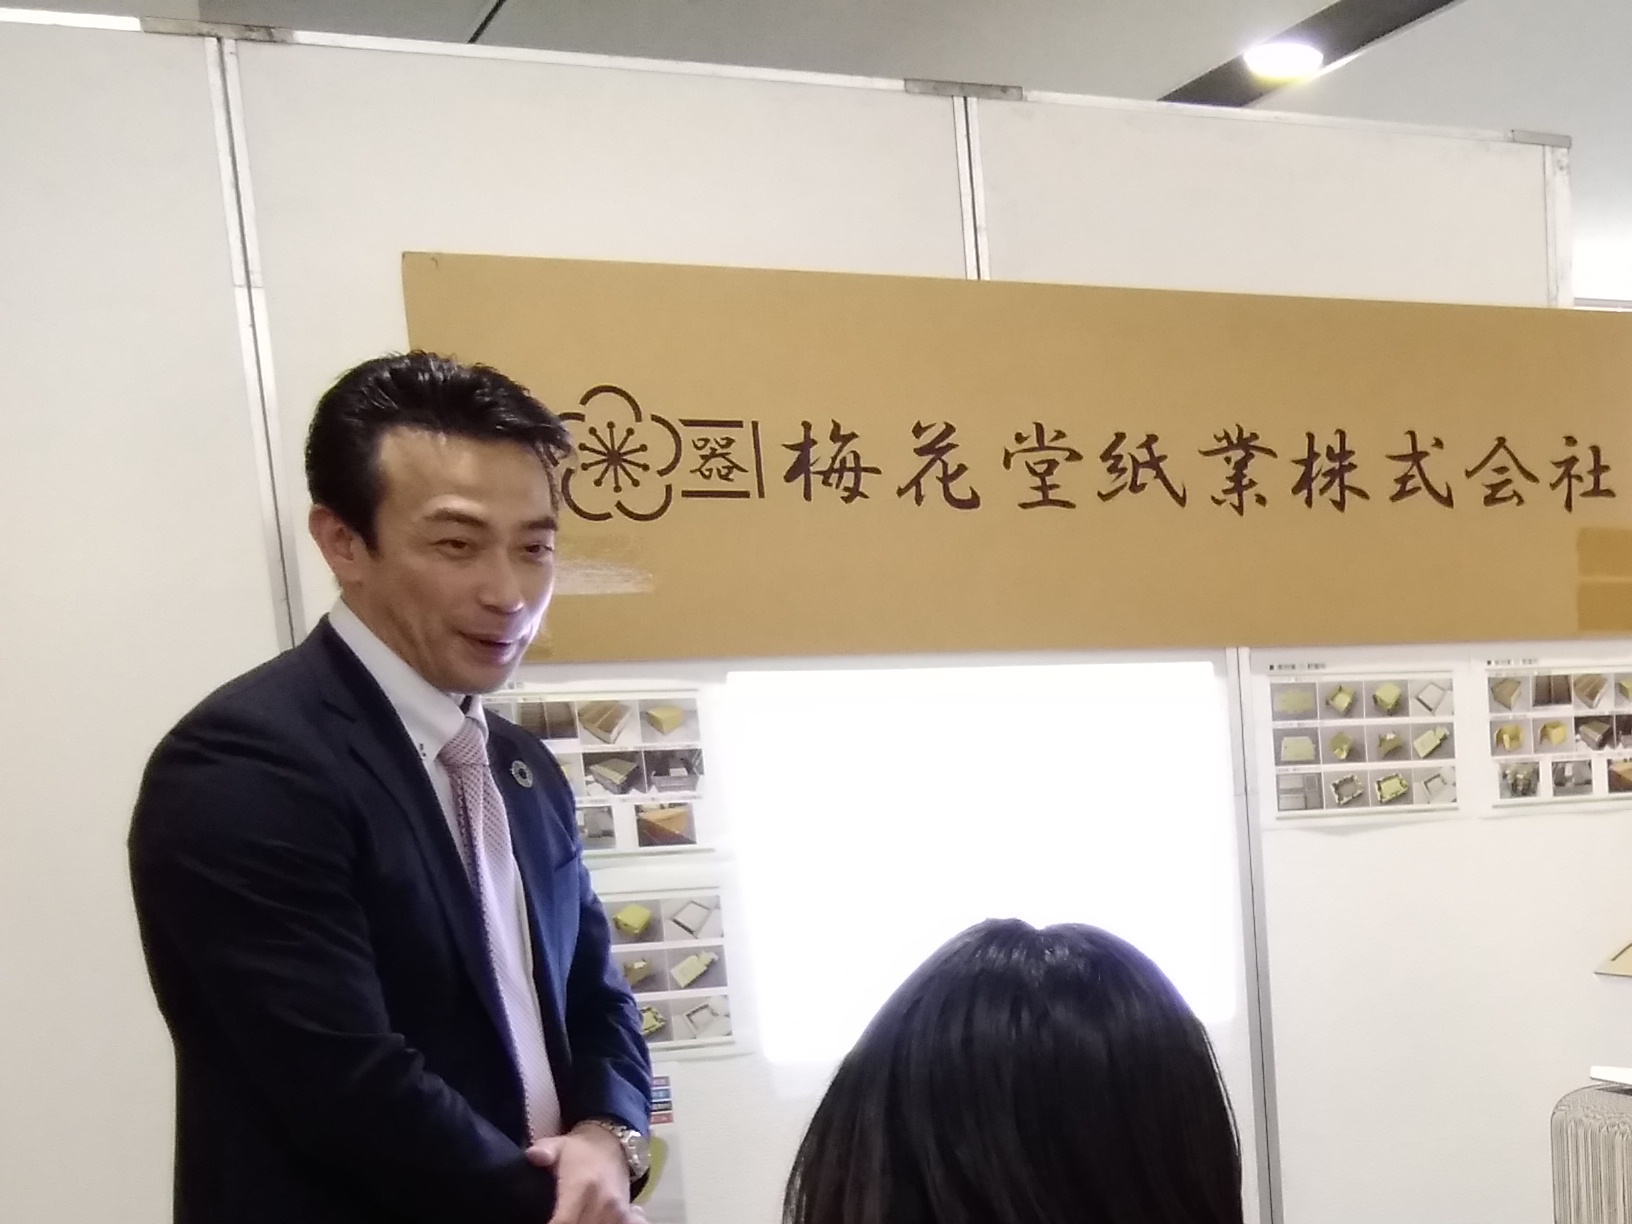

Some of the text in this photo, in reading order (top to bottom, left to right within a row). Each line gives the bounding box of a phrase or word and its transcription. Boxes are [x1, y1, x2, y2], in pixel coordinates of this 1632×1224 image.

[783, 419, 1618, 516] 梅花堂紙業株式会社
